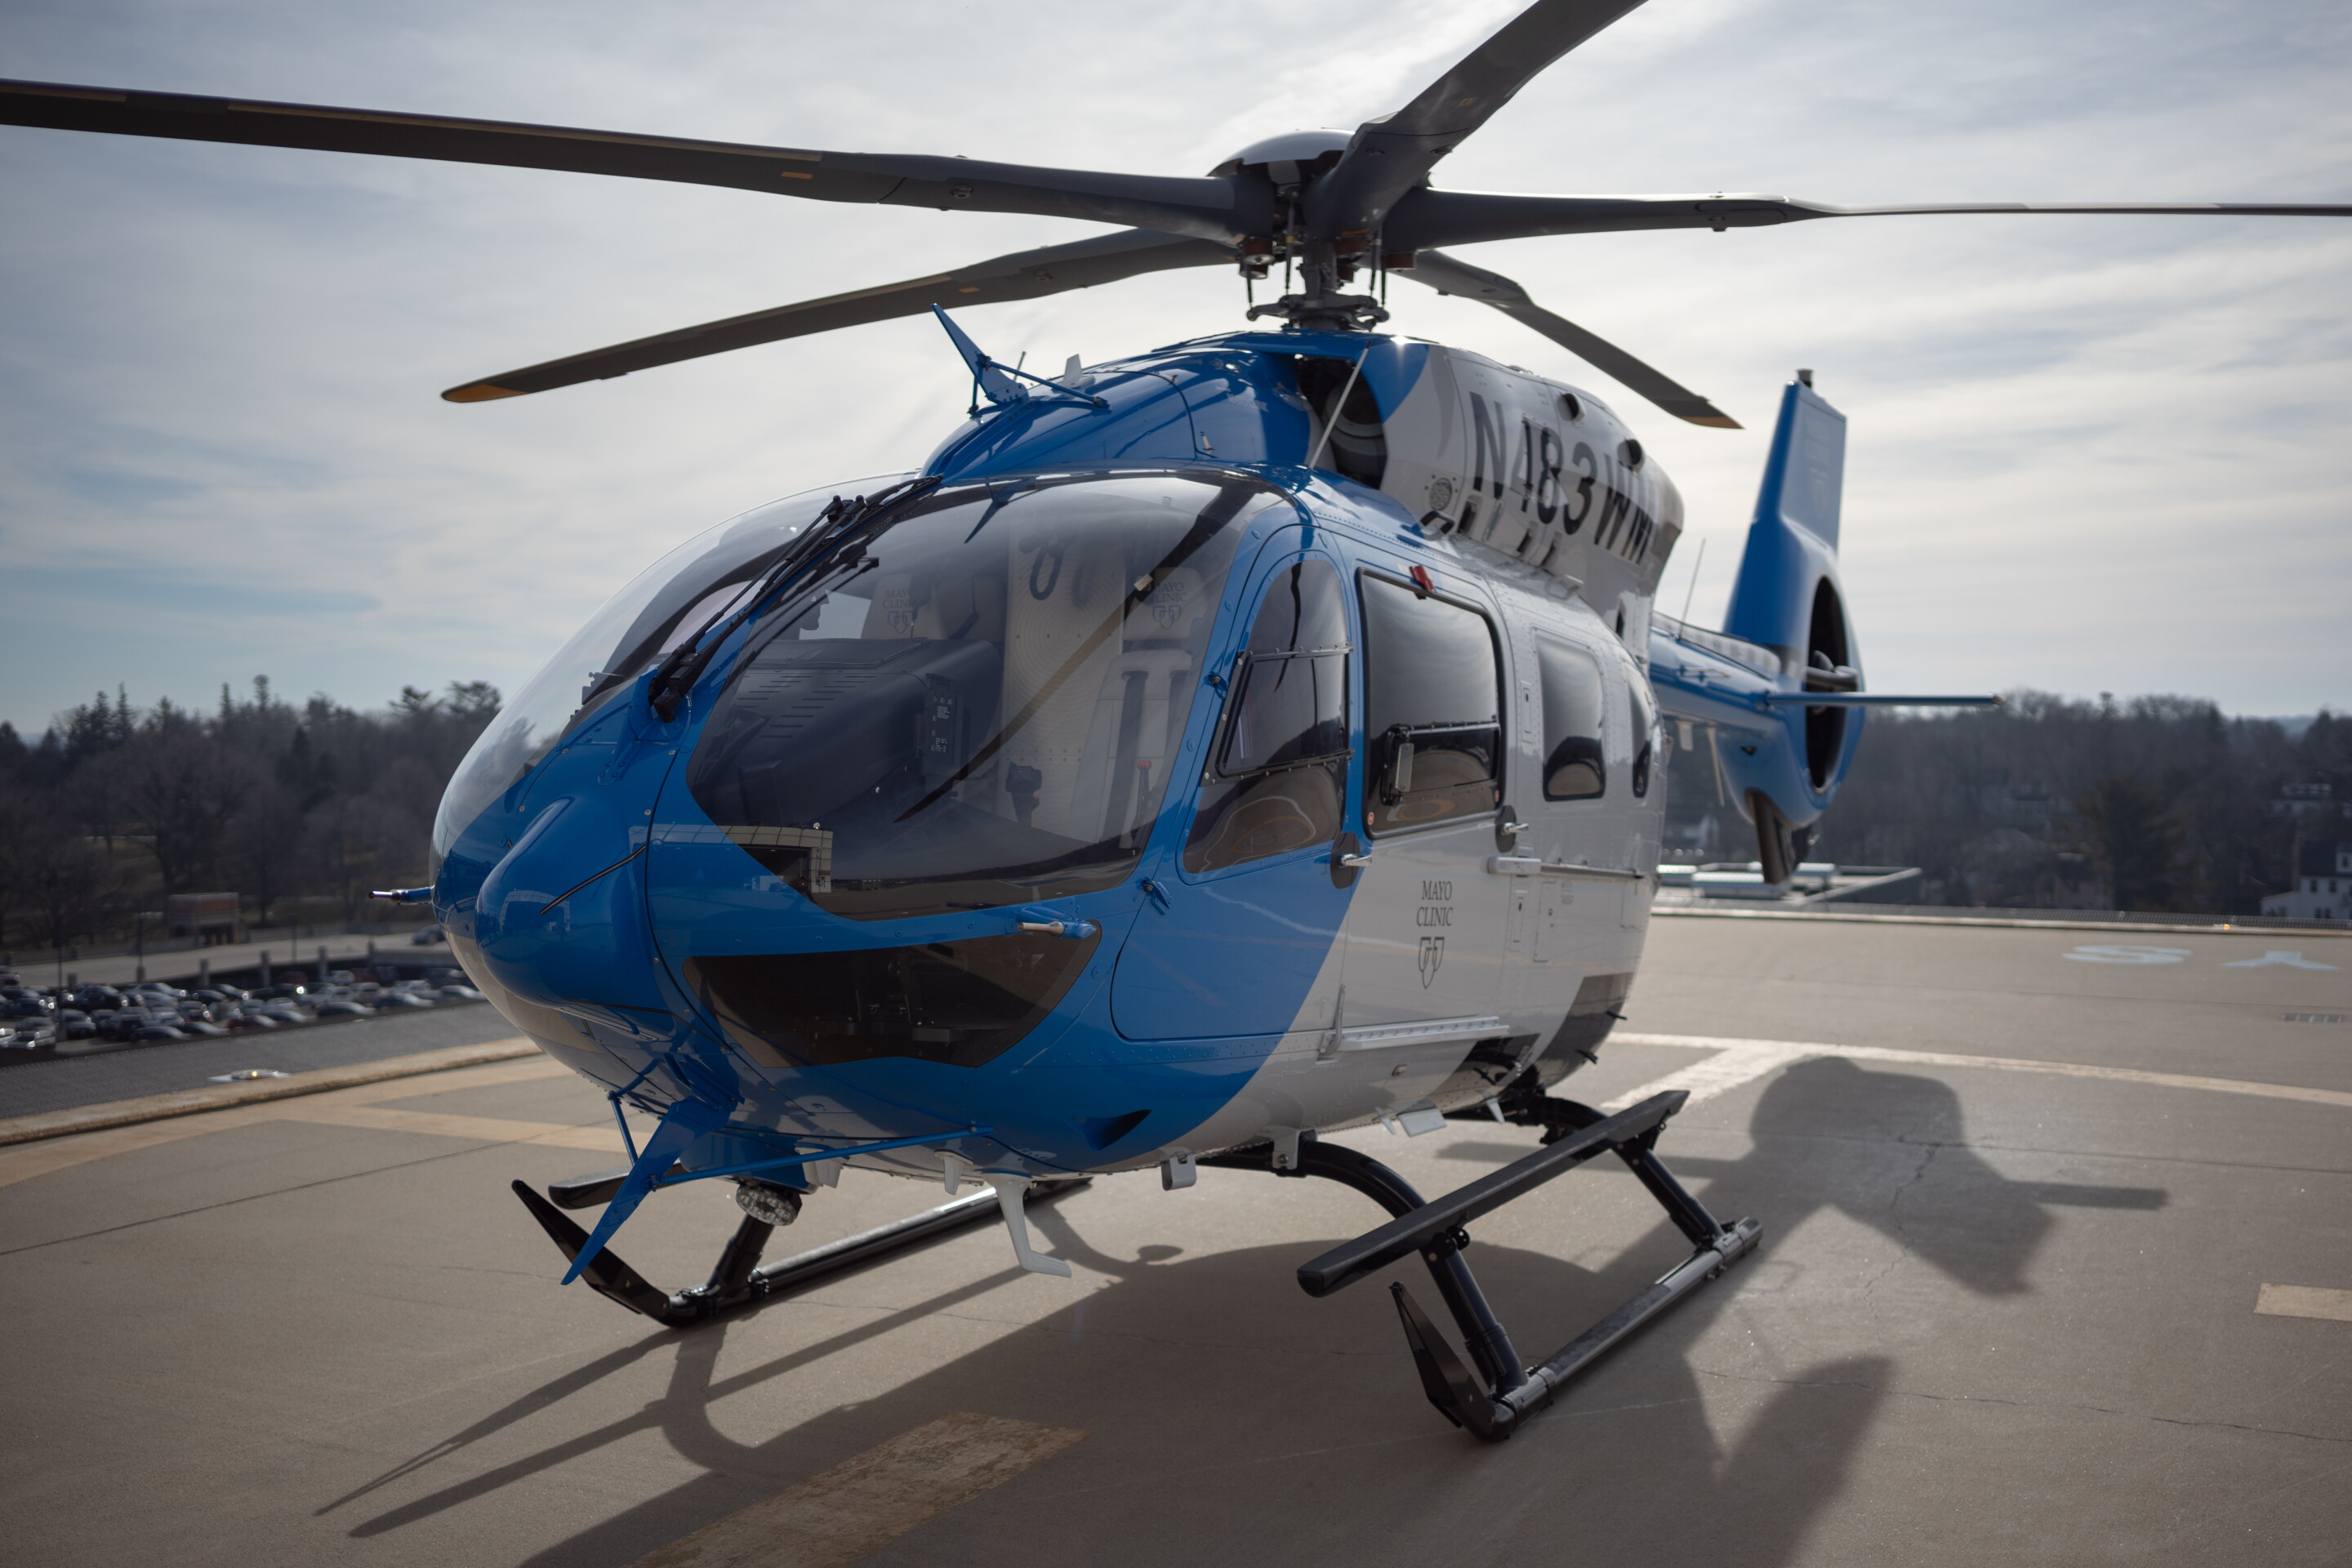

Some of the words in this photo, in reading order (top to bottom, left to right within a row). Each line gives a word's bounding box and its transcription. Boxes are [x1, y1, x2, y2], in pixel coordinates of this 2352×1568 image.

[884, 588, 909, 599] MAY
[1155, 592, 1187, 603] LINIC
[1421, 880, 1453, 901] MAYO
[1416, 906, 1454, 927] CLINIC
